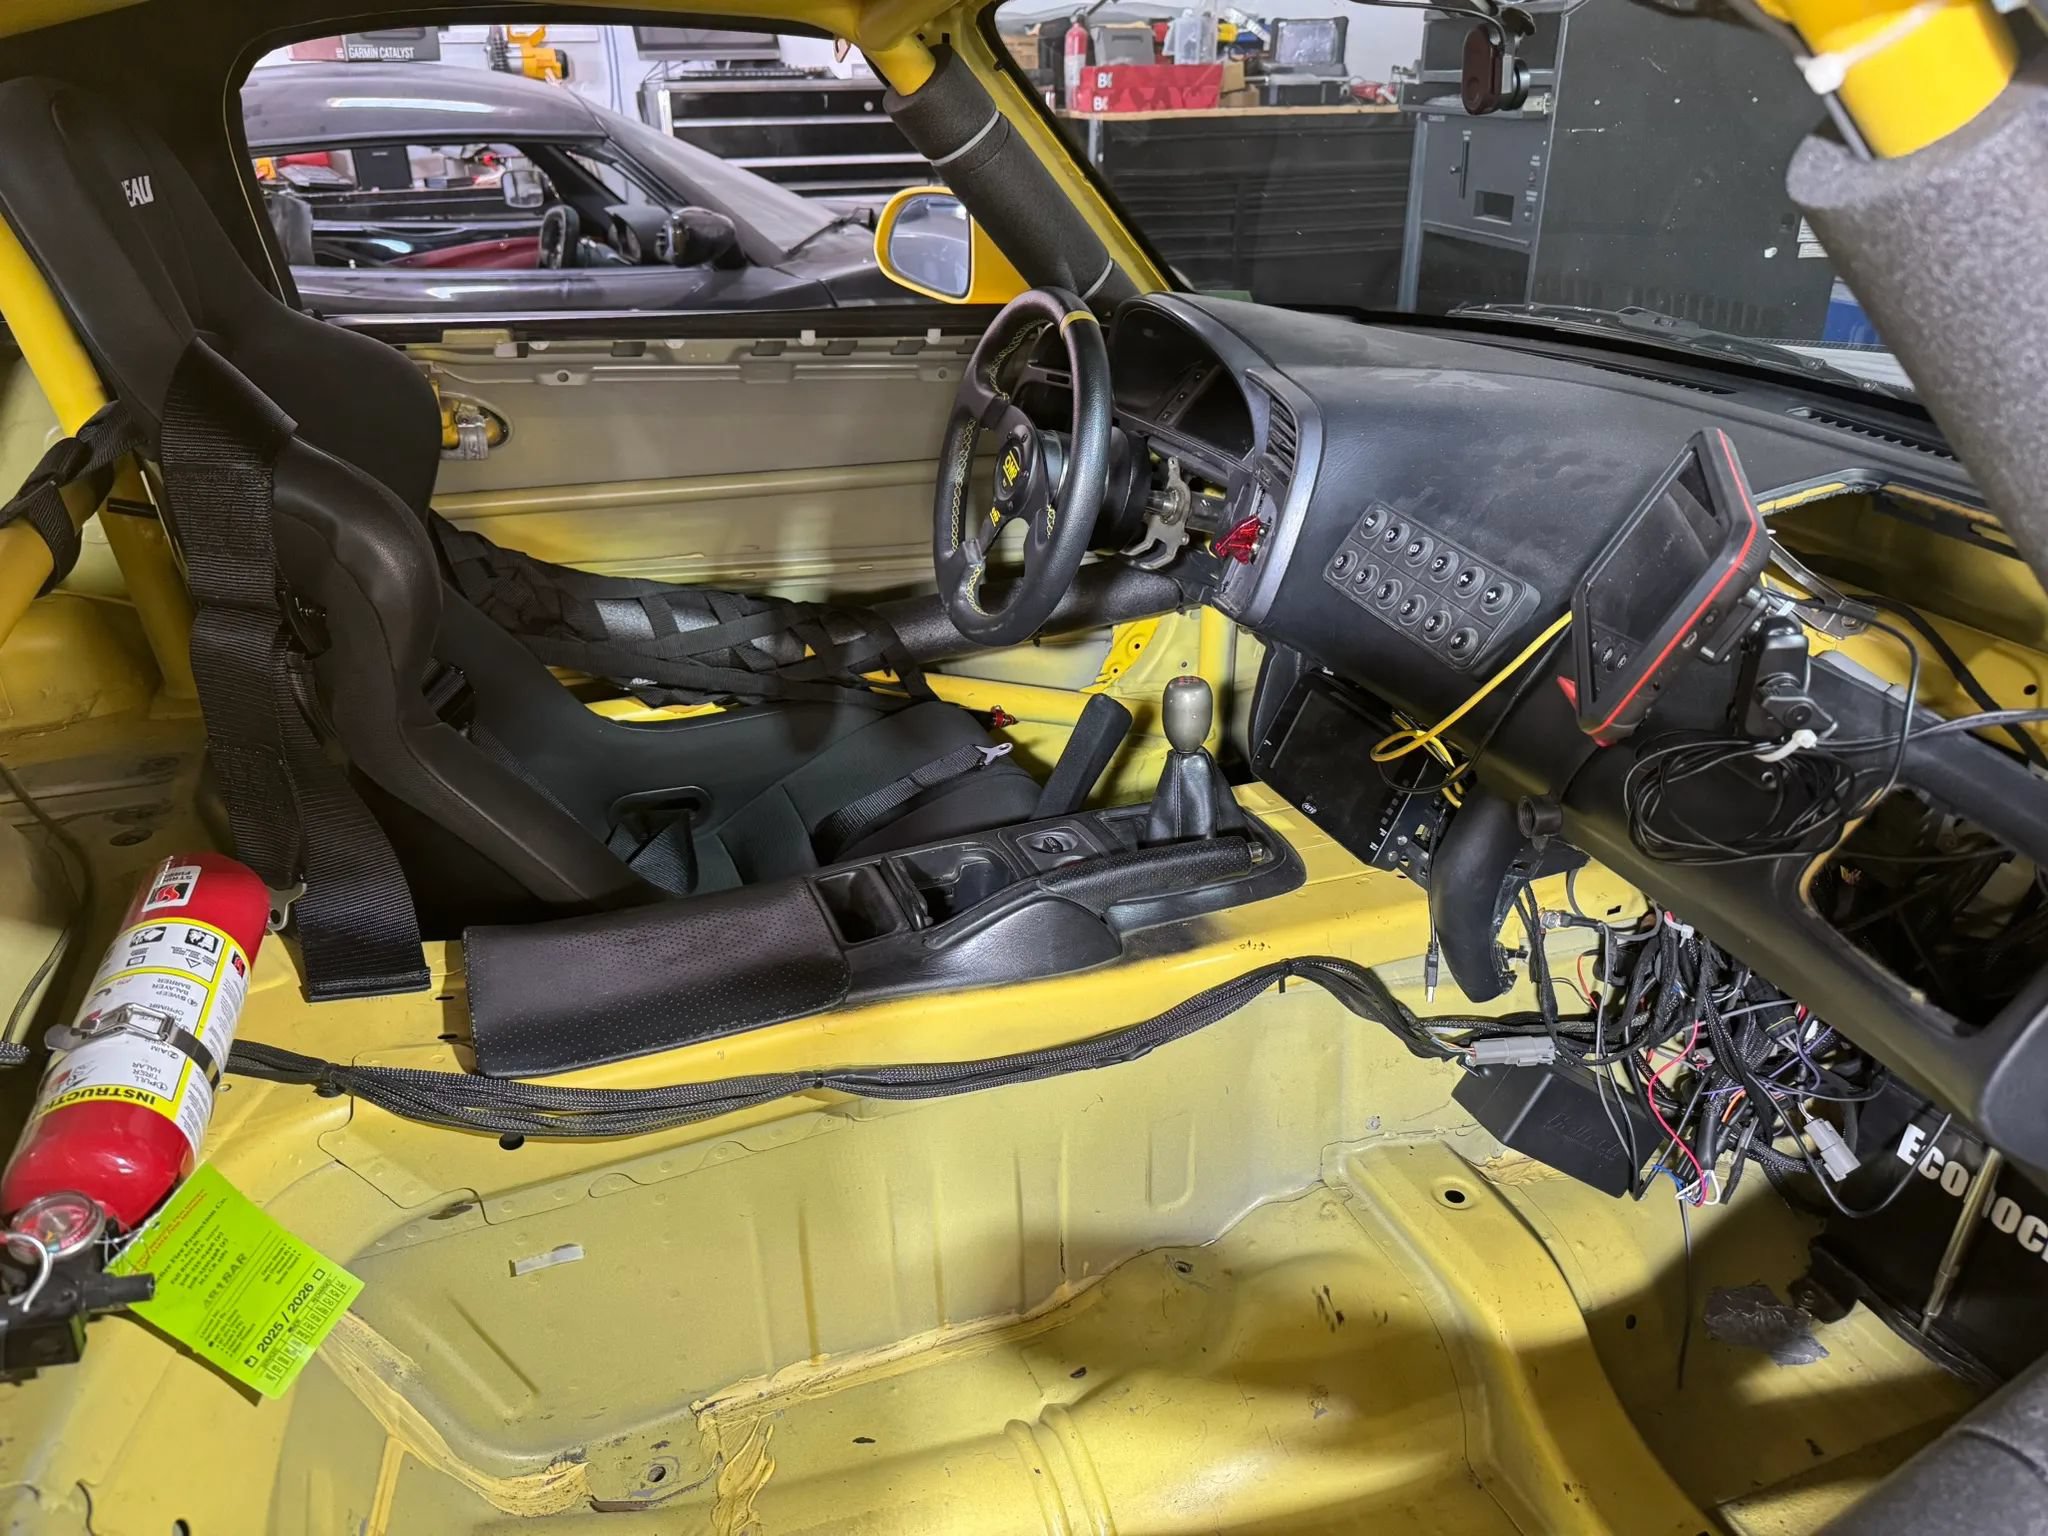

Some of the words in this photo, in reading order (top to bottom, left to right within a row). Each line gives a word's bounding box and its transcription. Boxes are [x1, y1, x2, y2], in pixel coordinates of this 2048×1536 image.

[349, 47, 378, 59] GARMIN
[379, 47, 415, 59] CATALYST
[155, 988, 186, 1001] SWEEP
[150, 1045, 168, 1054] AIM
[131, 1061, 161, 1074] HALAR
[133, 1074, 157, 1087] PULL
[46, 1087, 156, 1110] INSTRUCTI
[255, 1320, 285, 1353] 2025
[286, 1281, 315, 1314] 2026
